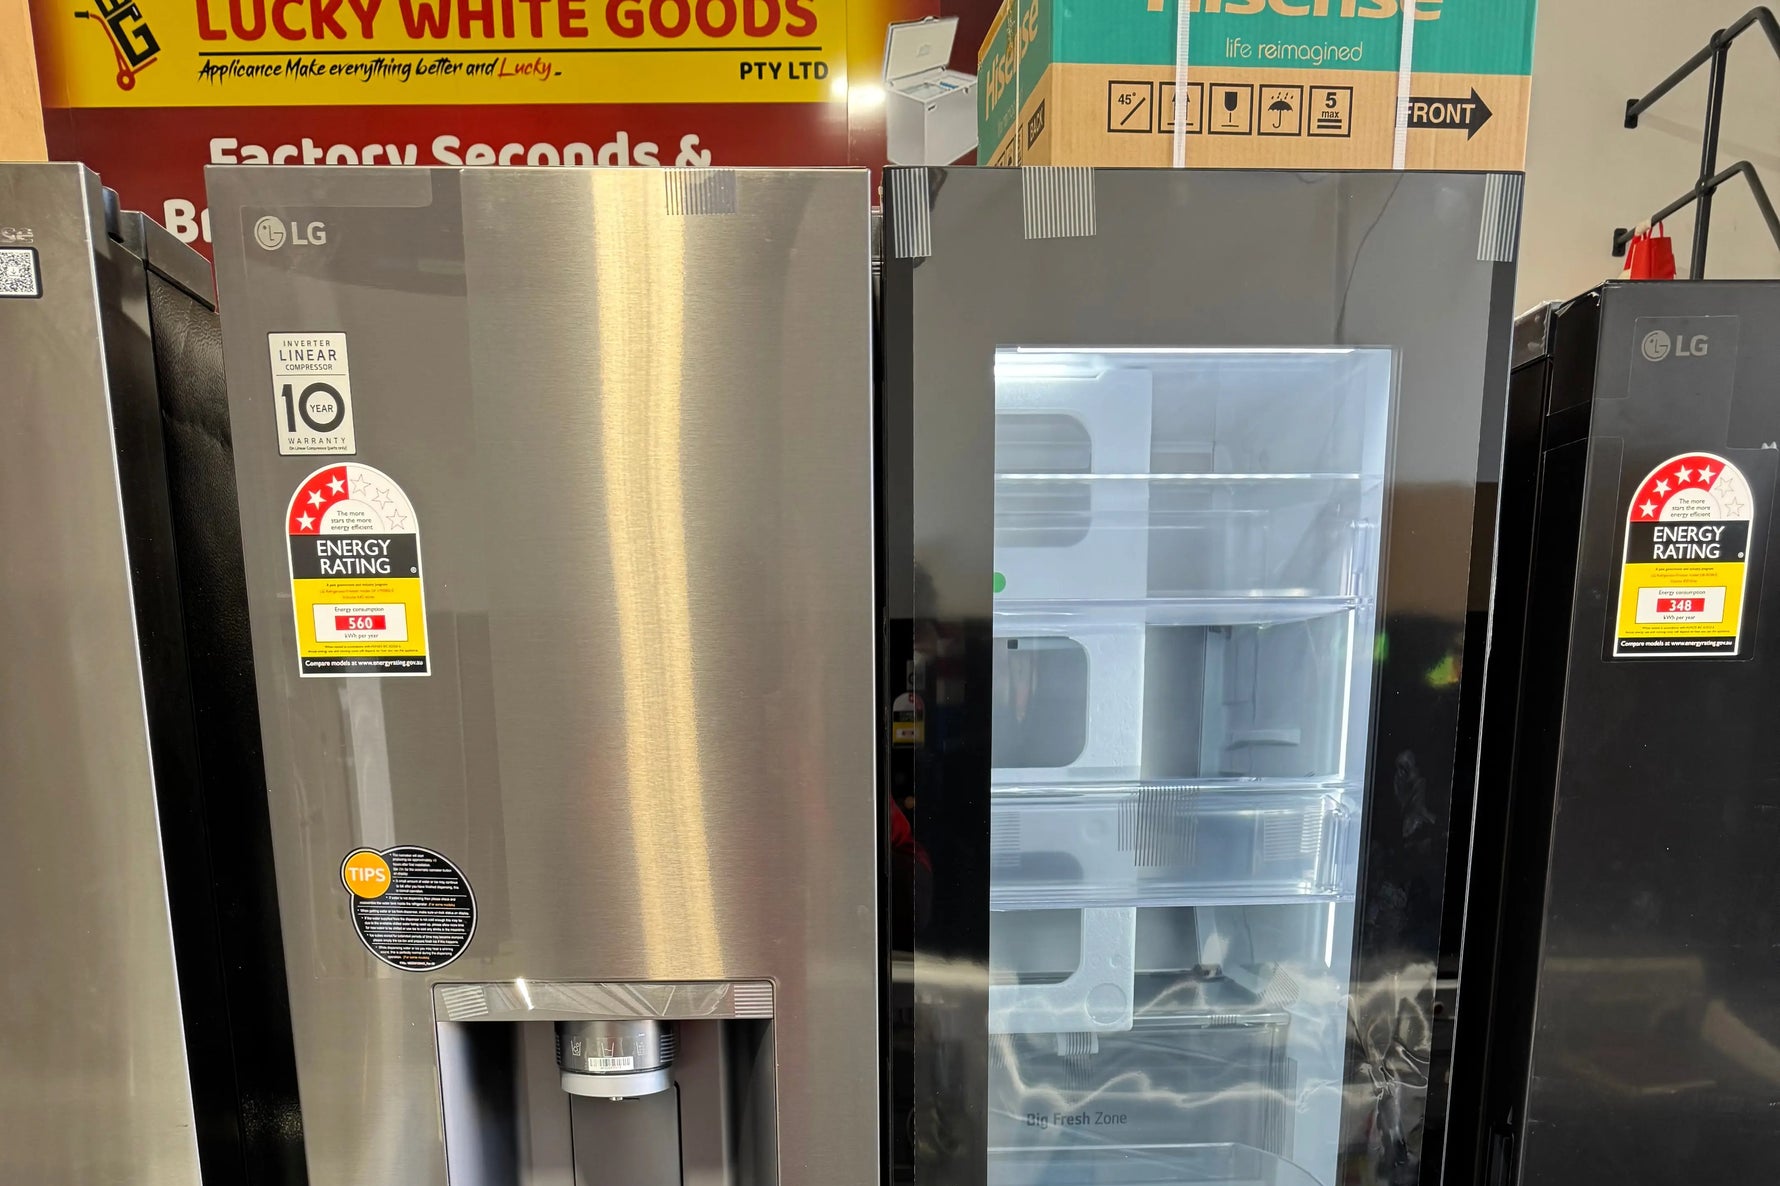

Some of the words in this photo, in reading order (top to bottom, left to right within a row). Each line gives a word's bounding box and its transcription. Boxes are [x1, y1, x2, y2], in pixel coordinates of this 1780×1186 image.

[196, 0, 381, 41] LUCKY
[399, 0, 589, 40] WHITE
[605, 0, 818, 38] GOODS
[1225, 38, 1252, 59] life
[1258, 41, 1363, 65] reimagined
[194, 59, 282, 87] Applicance
[285, 58, 326, 80] Make
[329, 57, 412, 83] everything
[415, 57, 463, 76] better
[466, 57, 499, 76] and
[740, 61, 782, 80] PTY
[788, 61, 829, 80] LTD
[1325, 92, 1337, 109] 5
[1321, 110, 1340, 119] max
[1029, 105, 1045, 142] BACK
[675, 134, 712, 166] &
[291, 221, 327, 246] LG
[1675, 334, 1709, 357] LG
[279, 349, 337, 361] LINEAR
[281, 382, 346, 433] 10
[310, 404, 334, 413] YEAR
[1653, 526, 1725, 542] ENERGY
[316, 539, 391, 556] ENERGY
[1653, 544, 1721, 559] RATING
[320, 558, 391, 575] RATING
[1669, 600, 1692, 611] 348
[349, 617, 373, 629] 560
[1620, 640, 1645, 648] Compare
[348, 867, 386, 882] TIPS
[1053, 1112, 1090, 1126] Fresh
[1094, 1111, 1127, 1125] Zone
